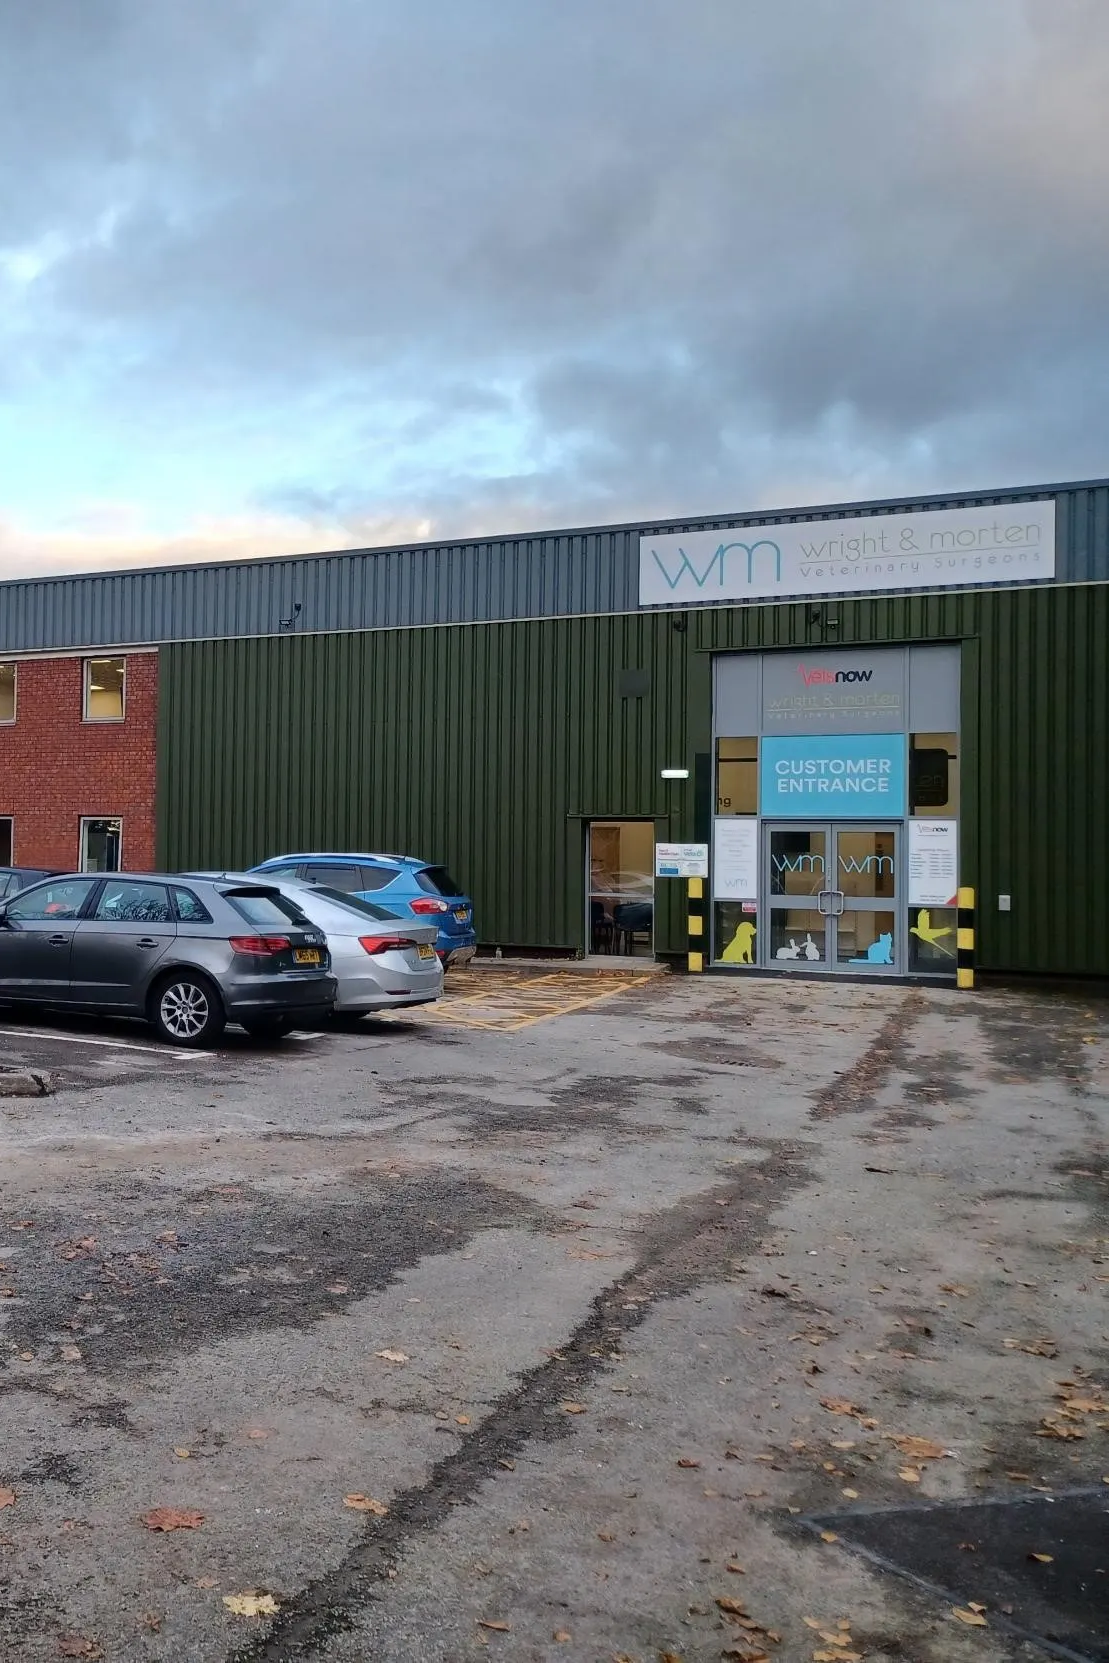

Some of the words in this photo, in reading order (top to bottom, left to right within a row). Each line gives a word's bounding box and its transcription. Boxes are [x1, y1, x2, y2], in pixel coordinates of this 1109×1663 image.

[799, 530, 890, 562] wright
[899, 528, 920, 551] &
[930, 520, 1041, 550] morten
[651, 540, 781, 589] wm
[800, 560, 919, 578] Veterinary
[934, 550, 1041, 569] Surgeons
[775, 758, 891, 775] CUSTOMER
[777, 777, 889, 794] ENTRANCE
[771, 854, 825, 873] wm
[839, 854, 894, 874] wm
